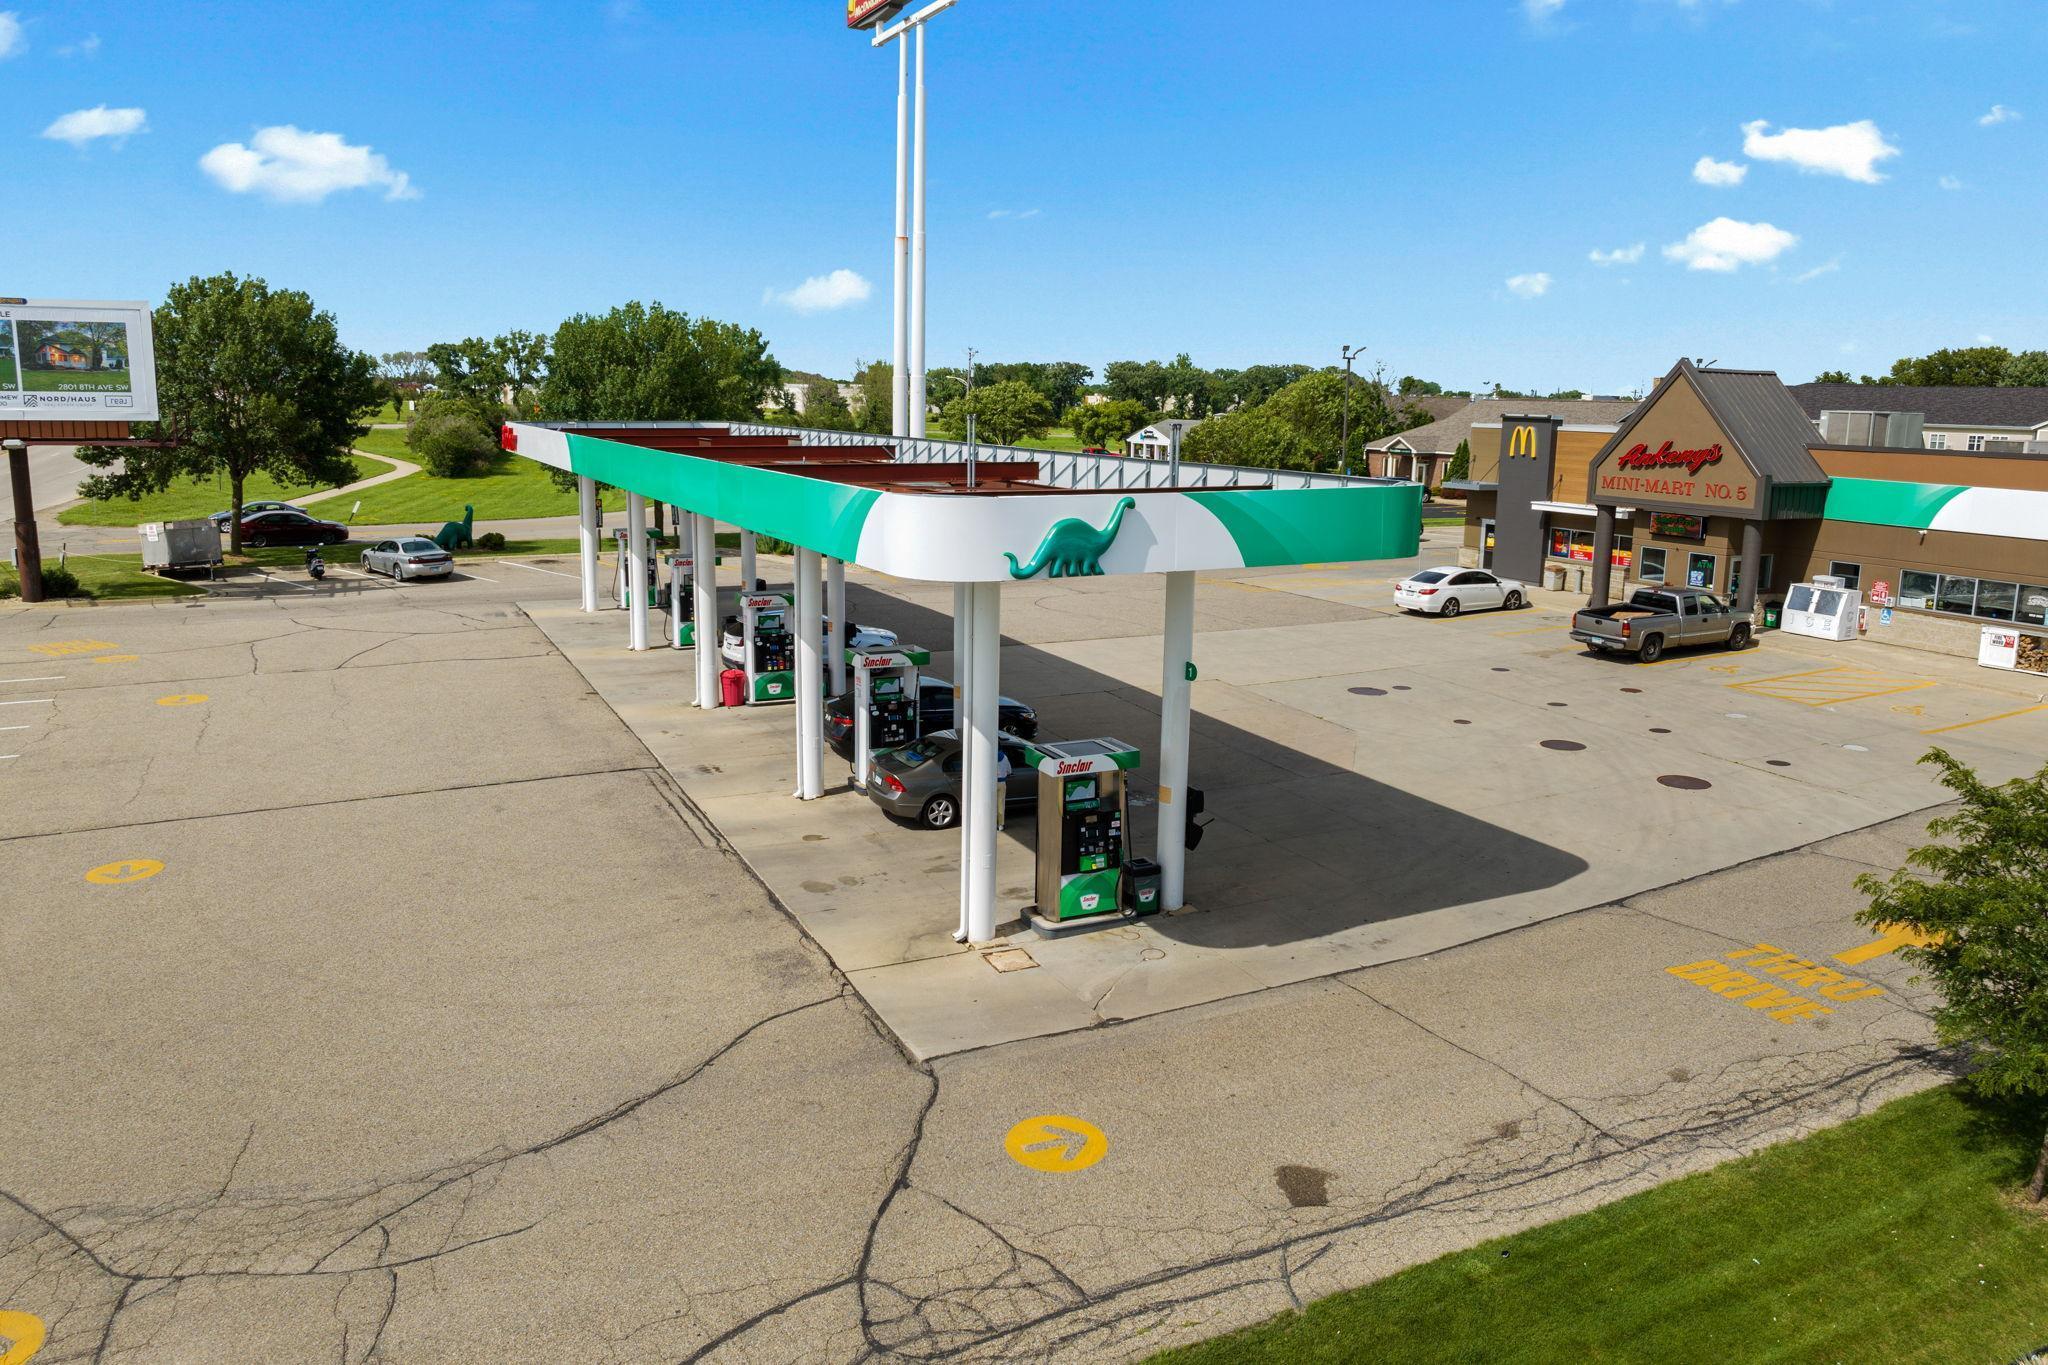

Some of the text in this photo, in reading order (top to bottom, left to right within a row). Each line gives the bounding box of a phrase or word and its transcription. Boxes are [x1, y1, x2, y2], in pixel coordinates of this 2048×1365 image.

[57, 383, 77, 391] 2801
[79, 383, 95, 391] 8TH
[1617, 440, 1723, 473] Ankeny's
[1601, 475, 1748, 501] MINI-MART NO. 5
[674, 558, 694, 567] Sinclai
[1697, 560, 1713, 569] ATM
[748, 597, 772, 608] Sinclair
[863, 656, 892, 667] Sinclair
[1056, 759, 1094, 775] Sinclair
[1724, 942, 1887, 1003] THRU
[1663, 959, 1837, 1025] DRIVE
